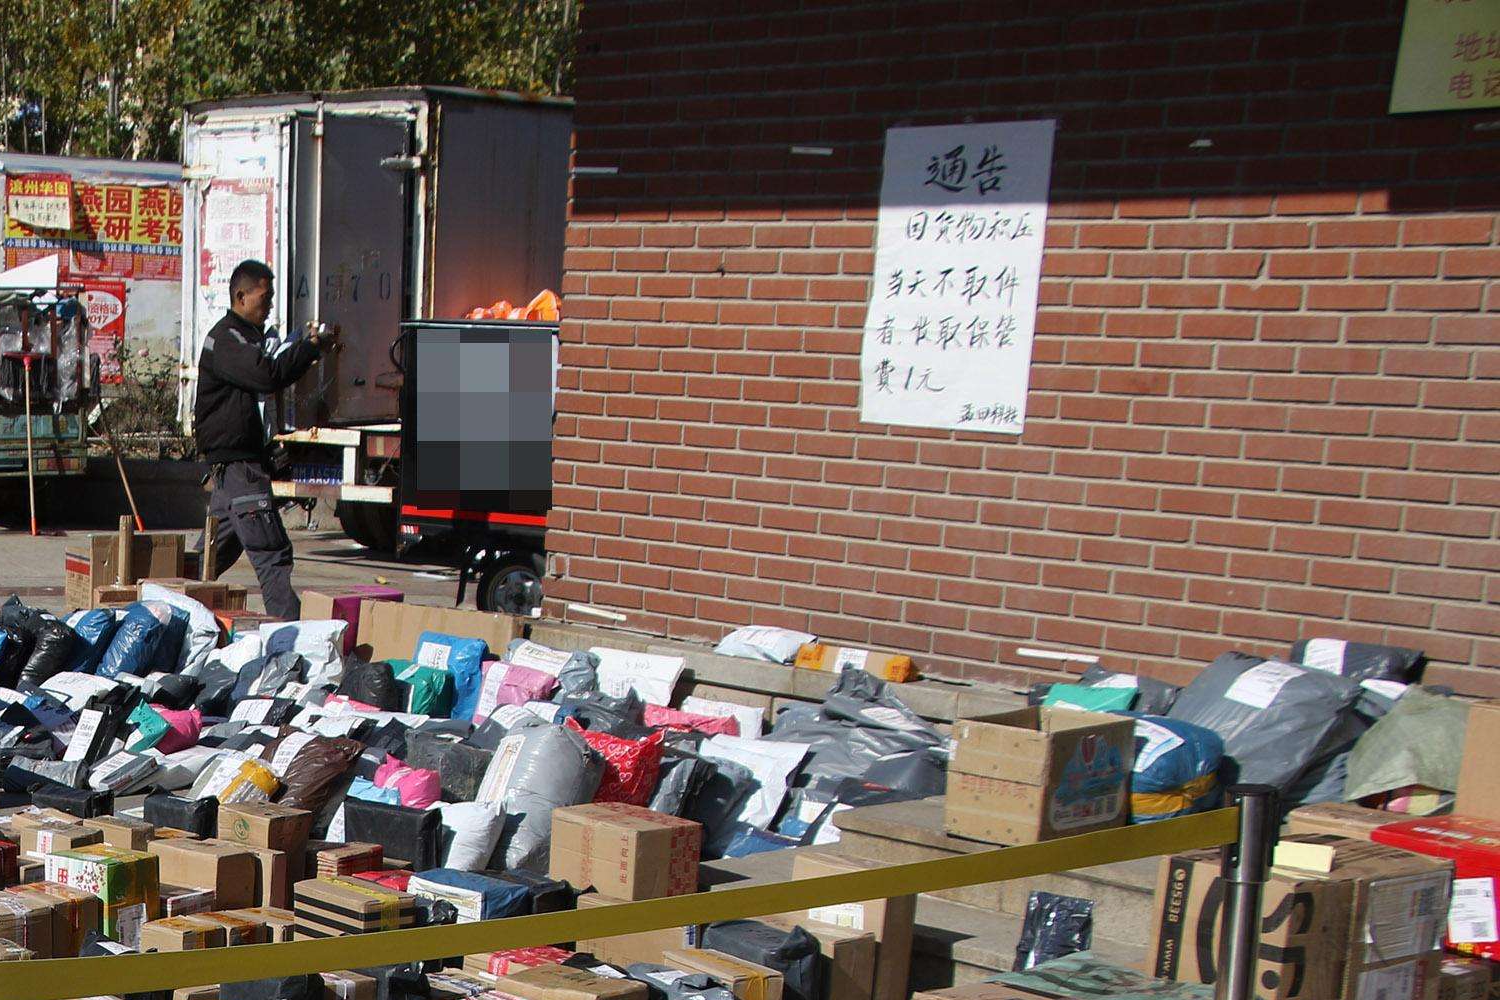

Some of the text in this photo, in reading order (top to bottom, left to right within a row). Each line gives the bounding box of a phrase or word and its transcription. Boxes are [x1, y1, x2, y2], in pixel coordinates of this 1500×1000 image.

[923, 144, 1007, 197] 通告
[75, 186, 132, 215] 燕园
[76, 215, 132, 243] 考研
[885, 264, 1020, 310] 当天不取件
